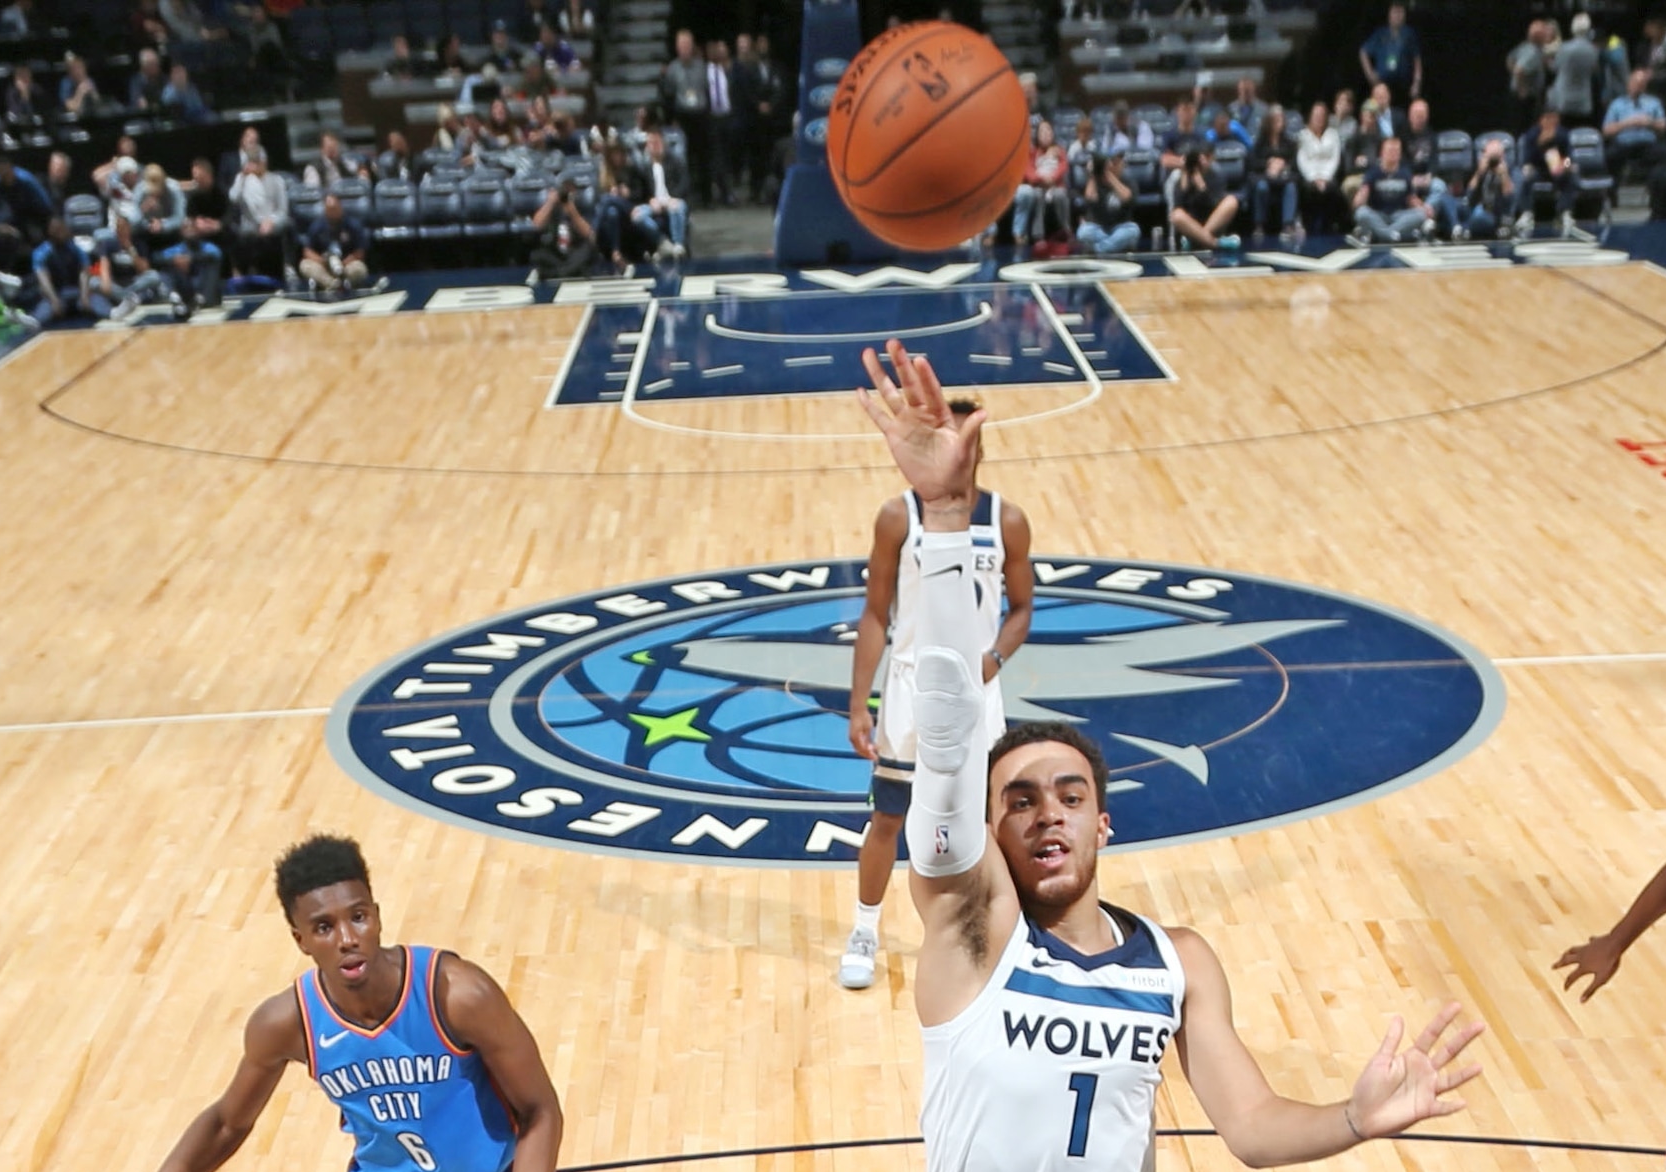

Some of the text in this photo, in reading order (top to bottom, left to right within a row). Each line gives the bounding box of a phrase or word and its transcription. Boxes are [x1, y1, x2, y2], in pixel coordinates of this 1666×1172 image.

[392, 563, 1234, 699] TIMBERWVES
[1131, 973, 1166, 988] fitbit
[1003, 1010, 1170, 1065] WOLVES
[319, 1054, 453, 1099] OKLAHOMA
[368, 1091, 422, 1123] CITY
[1067, 1072, 1099, 1158] 1
[397, 1131, 438, 1172] 6
